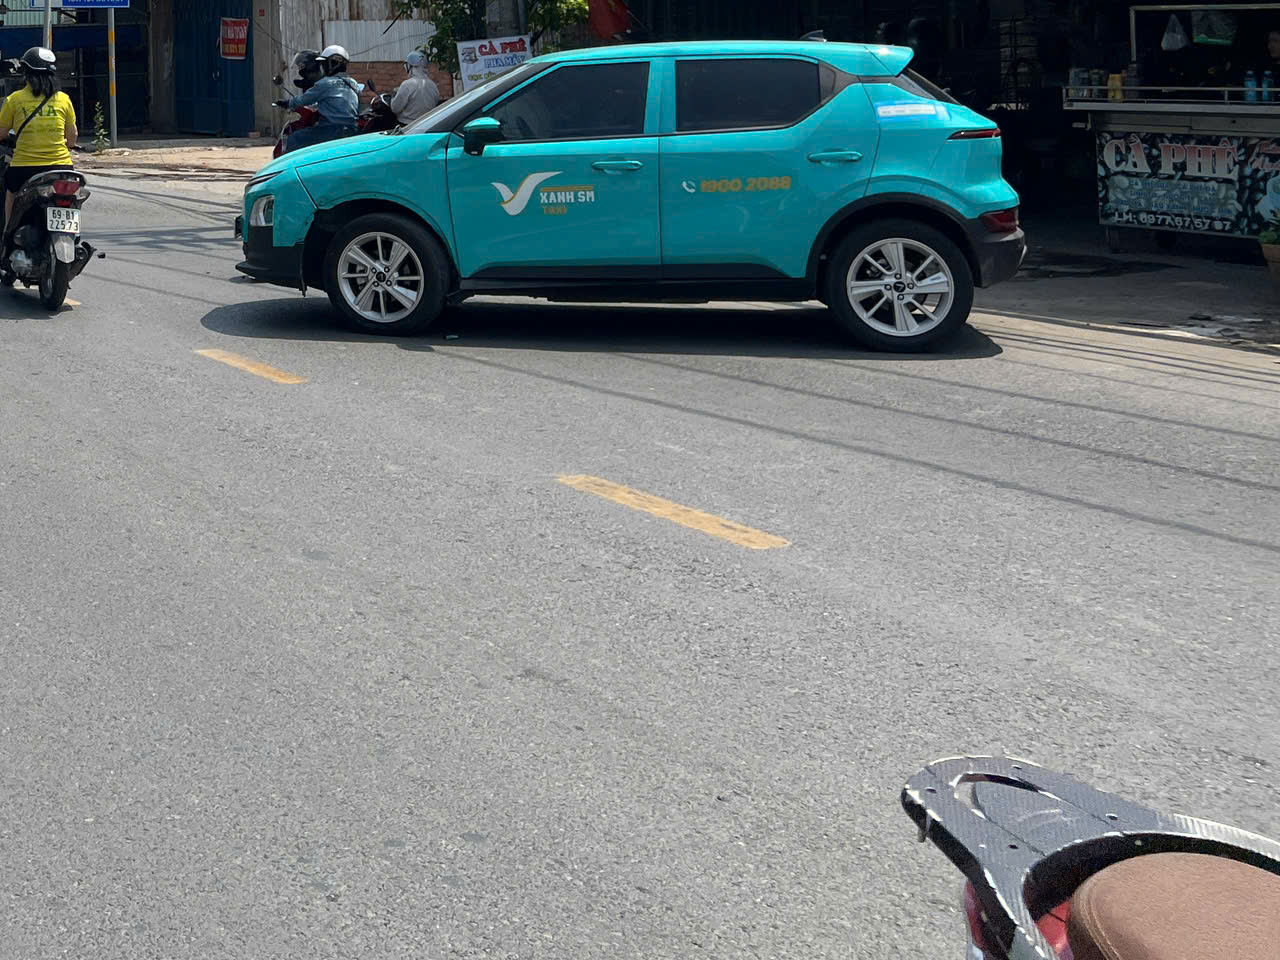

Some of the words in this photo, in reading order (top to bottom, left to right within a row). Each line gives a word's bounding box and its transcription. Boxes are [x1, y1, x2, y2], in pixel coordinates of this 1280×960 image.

[478, 40, 499, 56] CÀ
[500, 38, 528, 54] PHÊ
[1103, 133, 1152, 174] CÀ
[1158, 138, 1239, 180] PHÊ
[540, 191, 575, 203] XANH
[577, 190, 596, 203] SM
